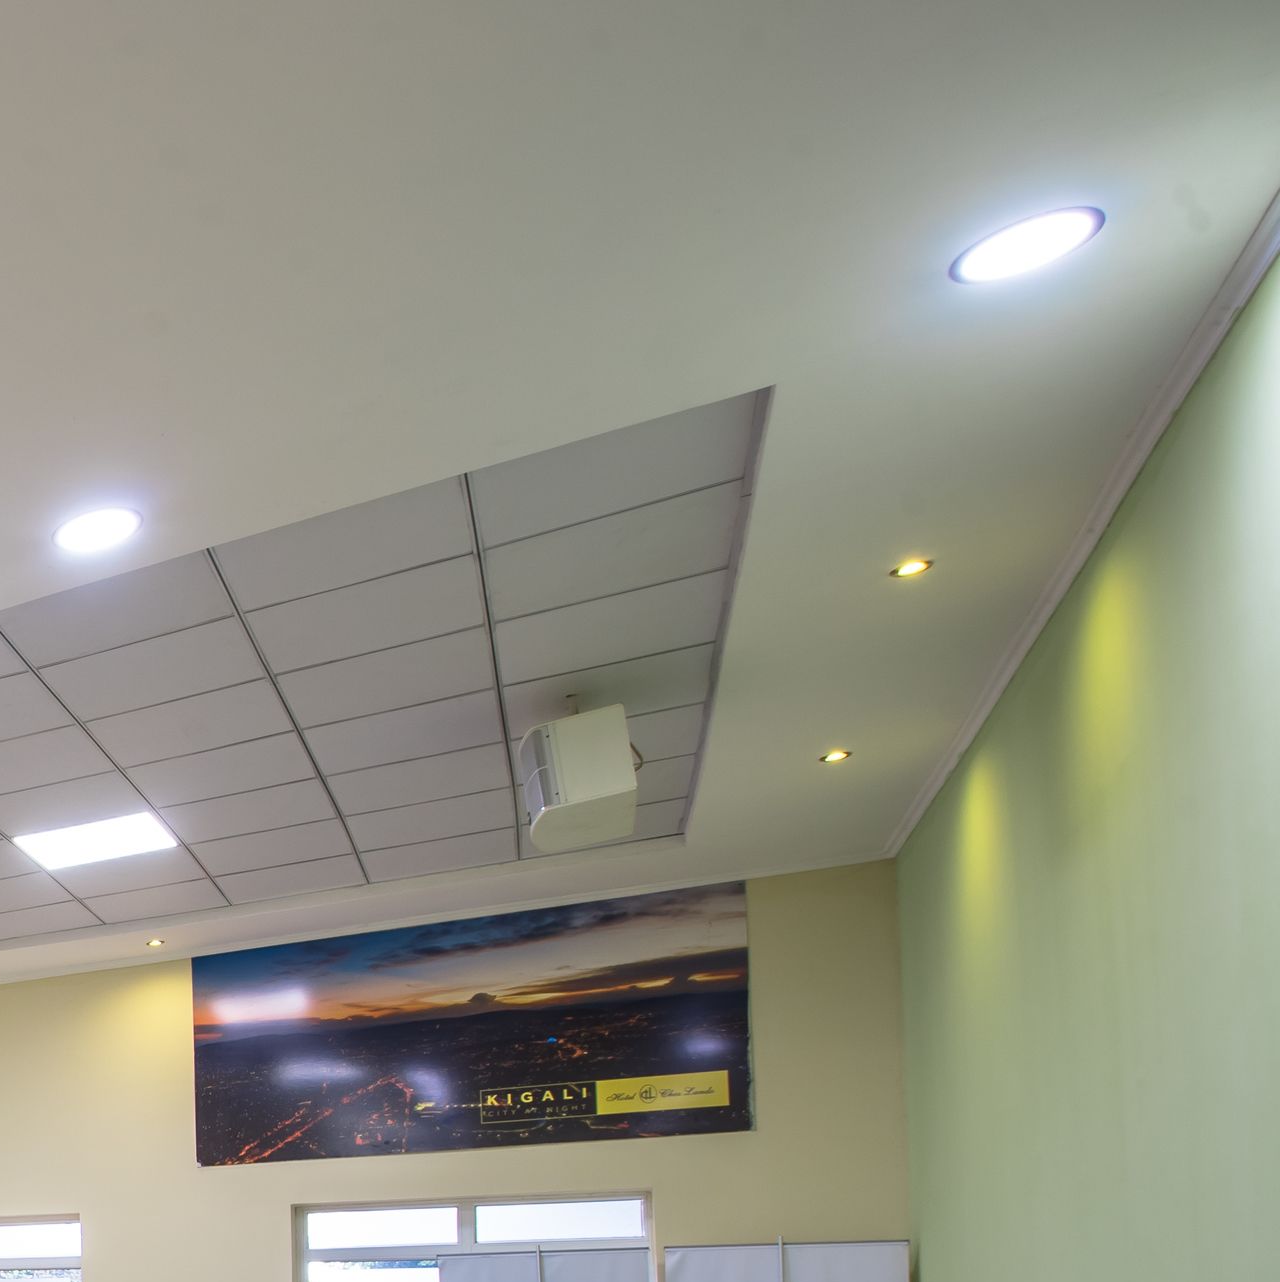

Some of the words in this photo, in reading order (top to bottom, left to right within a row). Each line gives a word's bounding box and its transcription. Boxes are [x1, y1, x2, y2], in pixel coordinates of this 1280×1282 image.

[487, 1087, 587, 1106] KIGALI
[606, 1092, 637, 1102] Hotel
[487, 1108, 517, 1117] CITY
[546, 1104, 587, 1113] NIGHT
